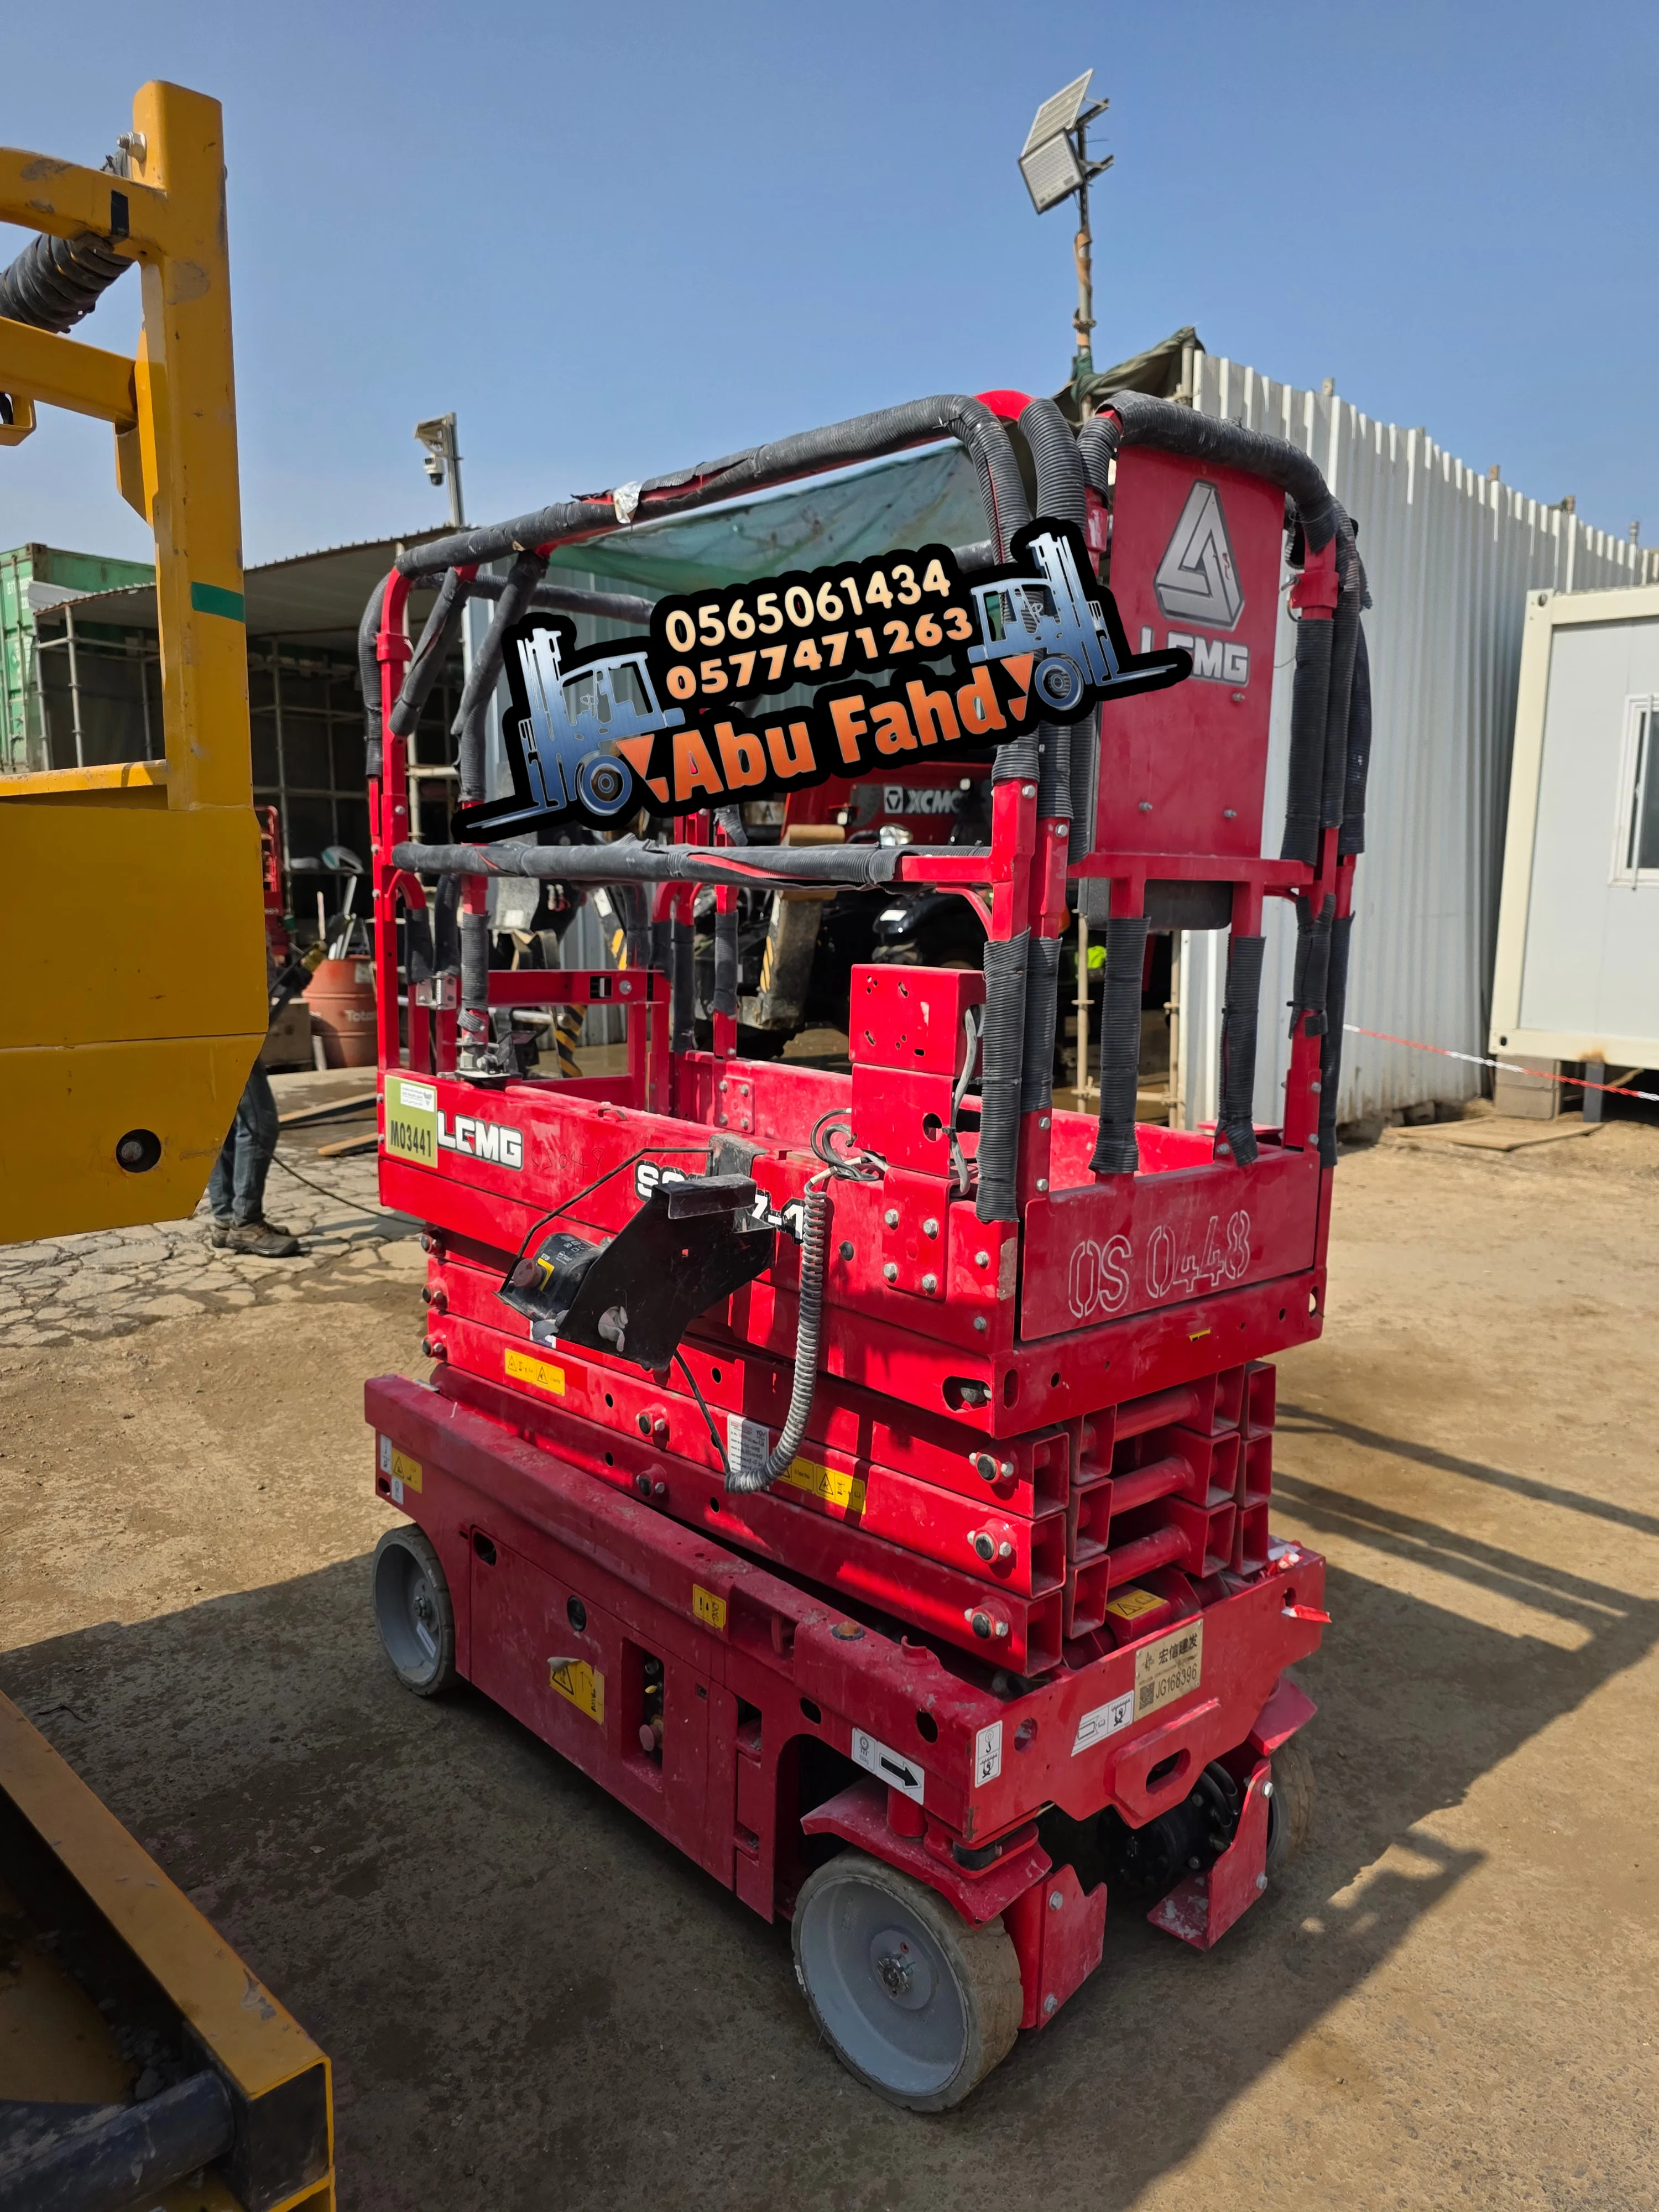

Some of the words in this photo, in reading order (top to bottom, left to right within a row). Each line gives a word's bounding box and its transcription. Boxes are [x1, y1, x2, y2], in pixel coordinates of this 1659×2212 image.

[390, 1120, 432, 1157] M03441
[1159, 1632, 1198, 1666] 宏信建发
[1155, 1662, 1198, 1699] JG168396
